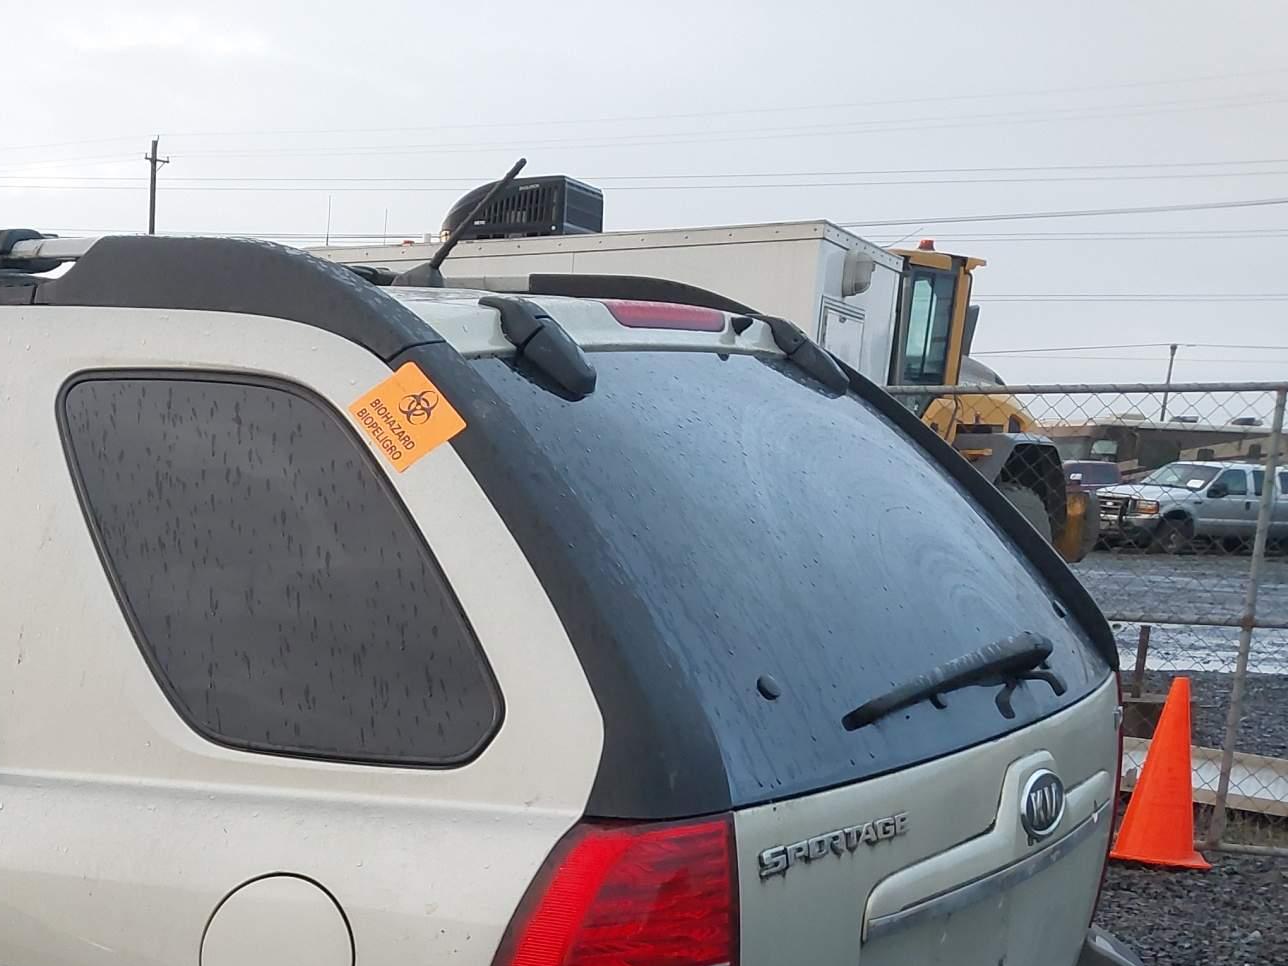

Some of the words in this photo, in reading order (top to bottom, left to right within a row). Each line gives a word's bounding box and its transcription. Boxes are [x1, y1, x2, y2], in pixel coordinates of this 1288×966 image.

[356, 408, 402, 461] BIOPELIGRO
[369, 398, 416, 450] BIOHAZARD
[1030, 782, 1057, 826] KIA
[759, 811, 911, 877] SPORTAGE
